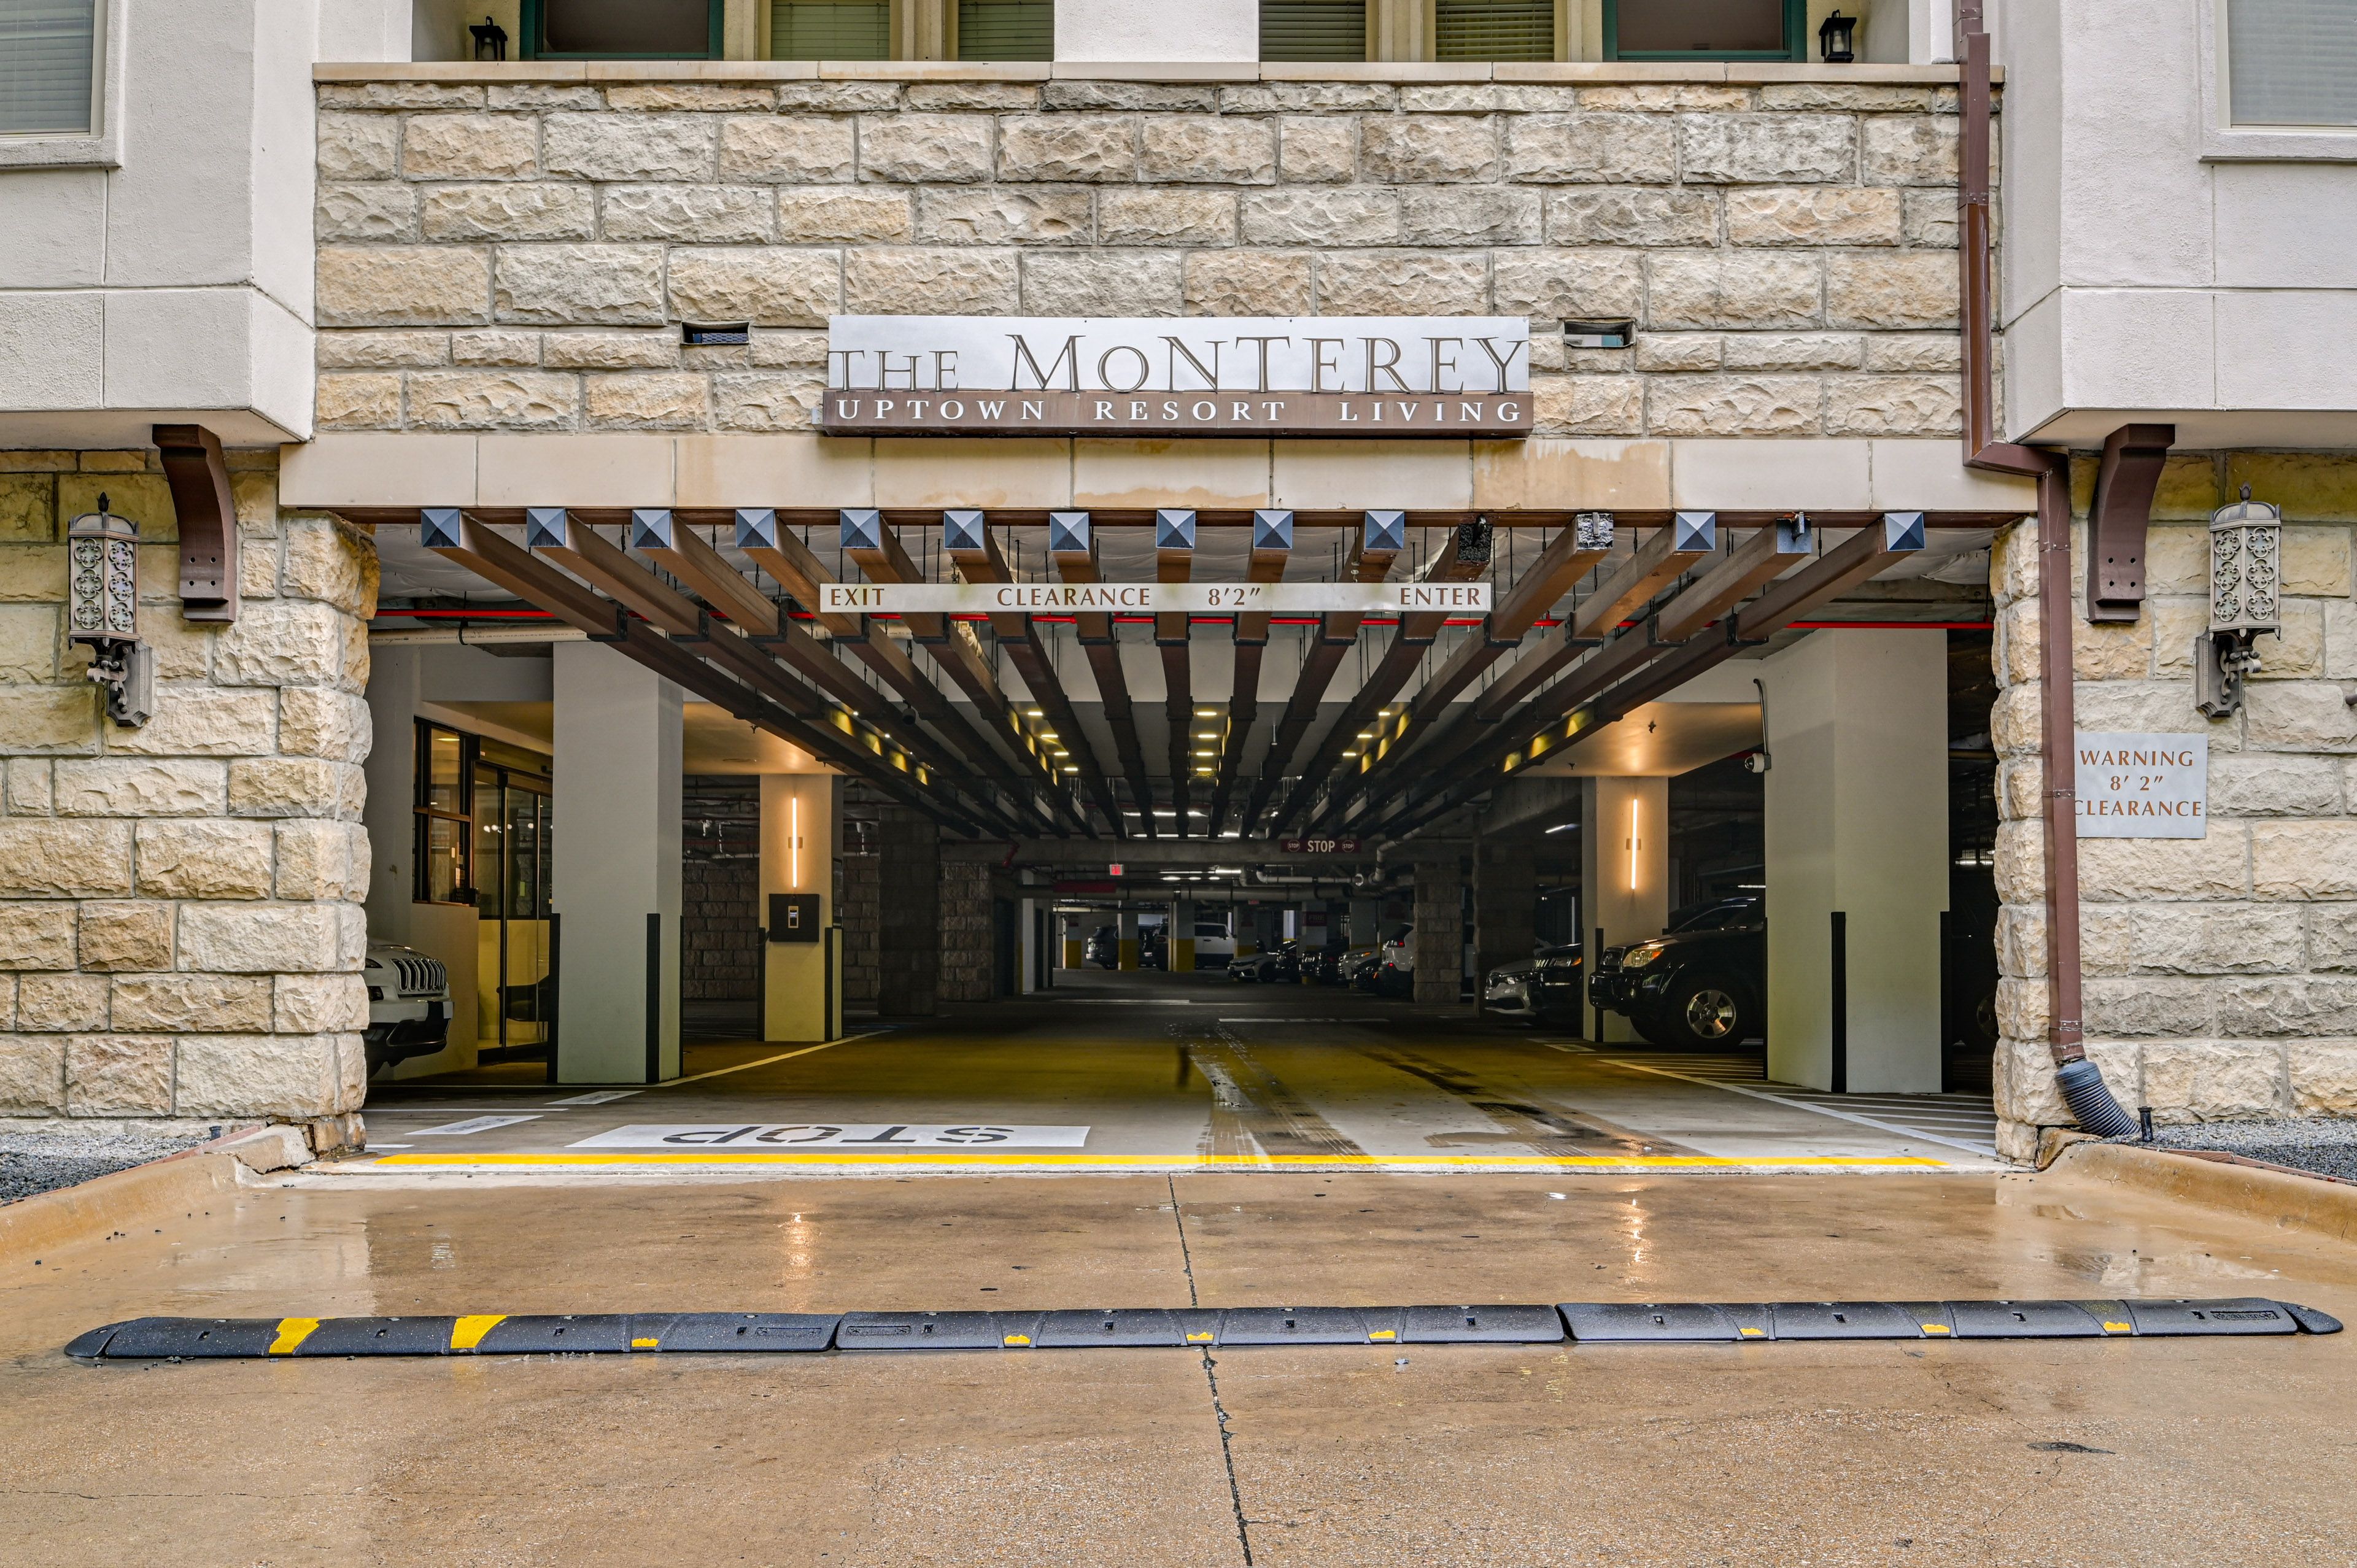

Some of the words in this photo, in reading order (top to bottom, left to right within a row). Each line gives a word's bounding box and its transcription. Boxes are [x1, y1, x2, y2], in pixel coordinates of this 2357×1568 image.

[827, 350, 958, 392] THE
[1005, 334, 1528, 395] MONTEREY
[835, 400, 1045, 420] UPTOWN
[1094, 401, 1284, 421] RESORT
[1339, 401, 1520, 422] LIVING
[830, 588, 884, 606] EXIT
[997, 588, 1151, 606] CLEARANCE
[1400, 587, 1480, 606] ENTER
[2080, 750, 2193, 767] WARNING
[2075, 800, 2202, 817] CLEARANCE
[1307, 840, 1335, 852] STOP
[662, 1126, 1015, 1144] STOP
